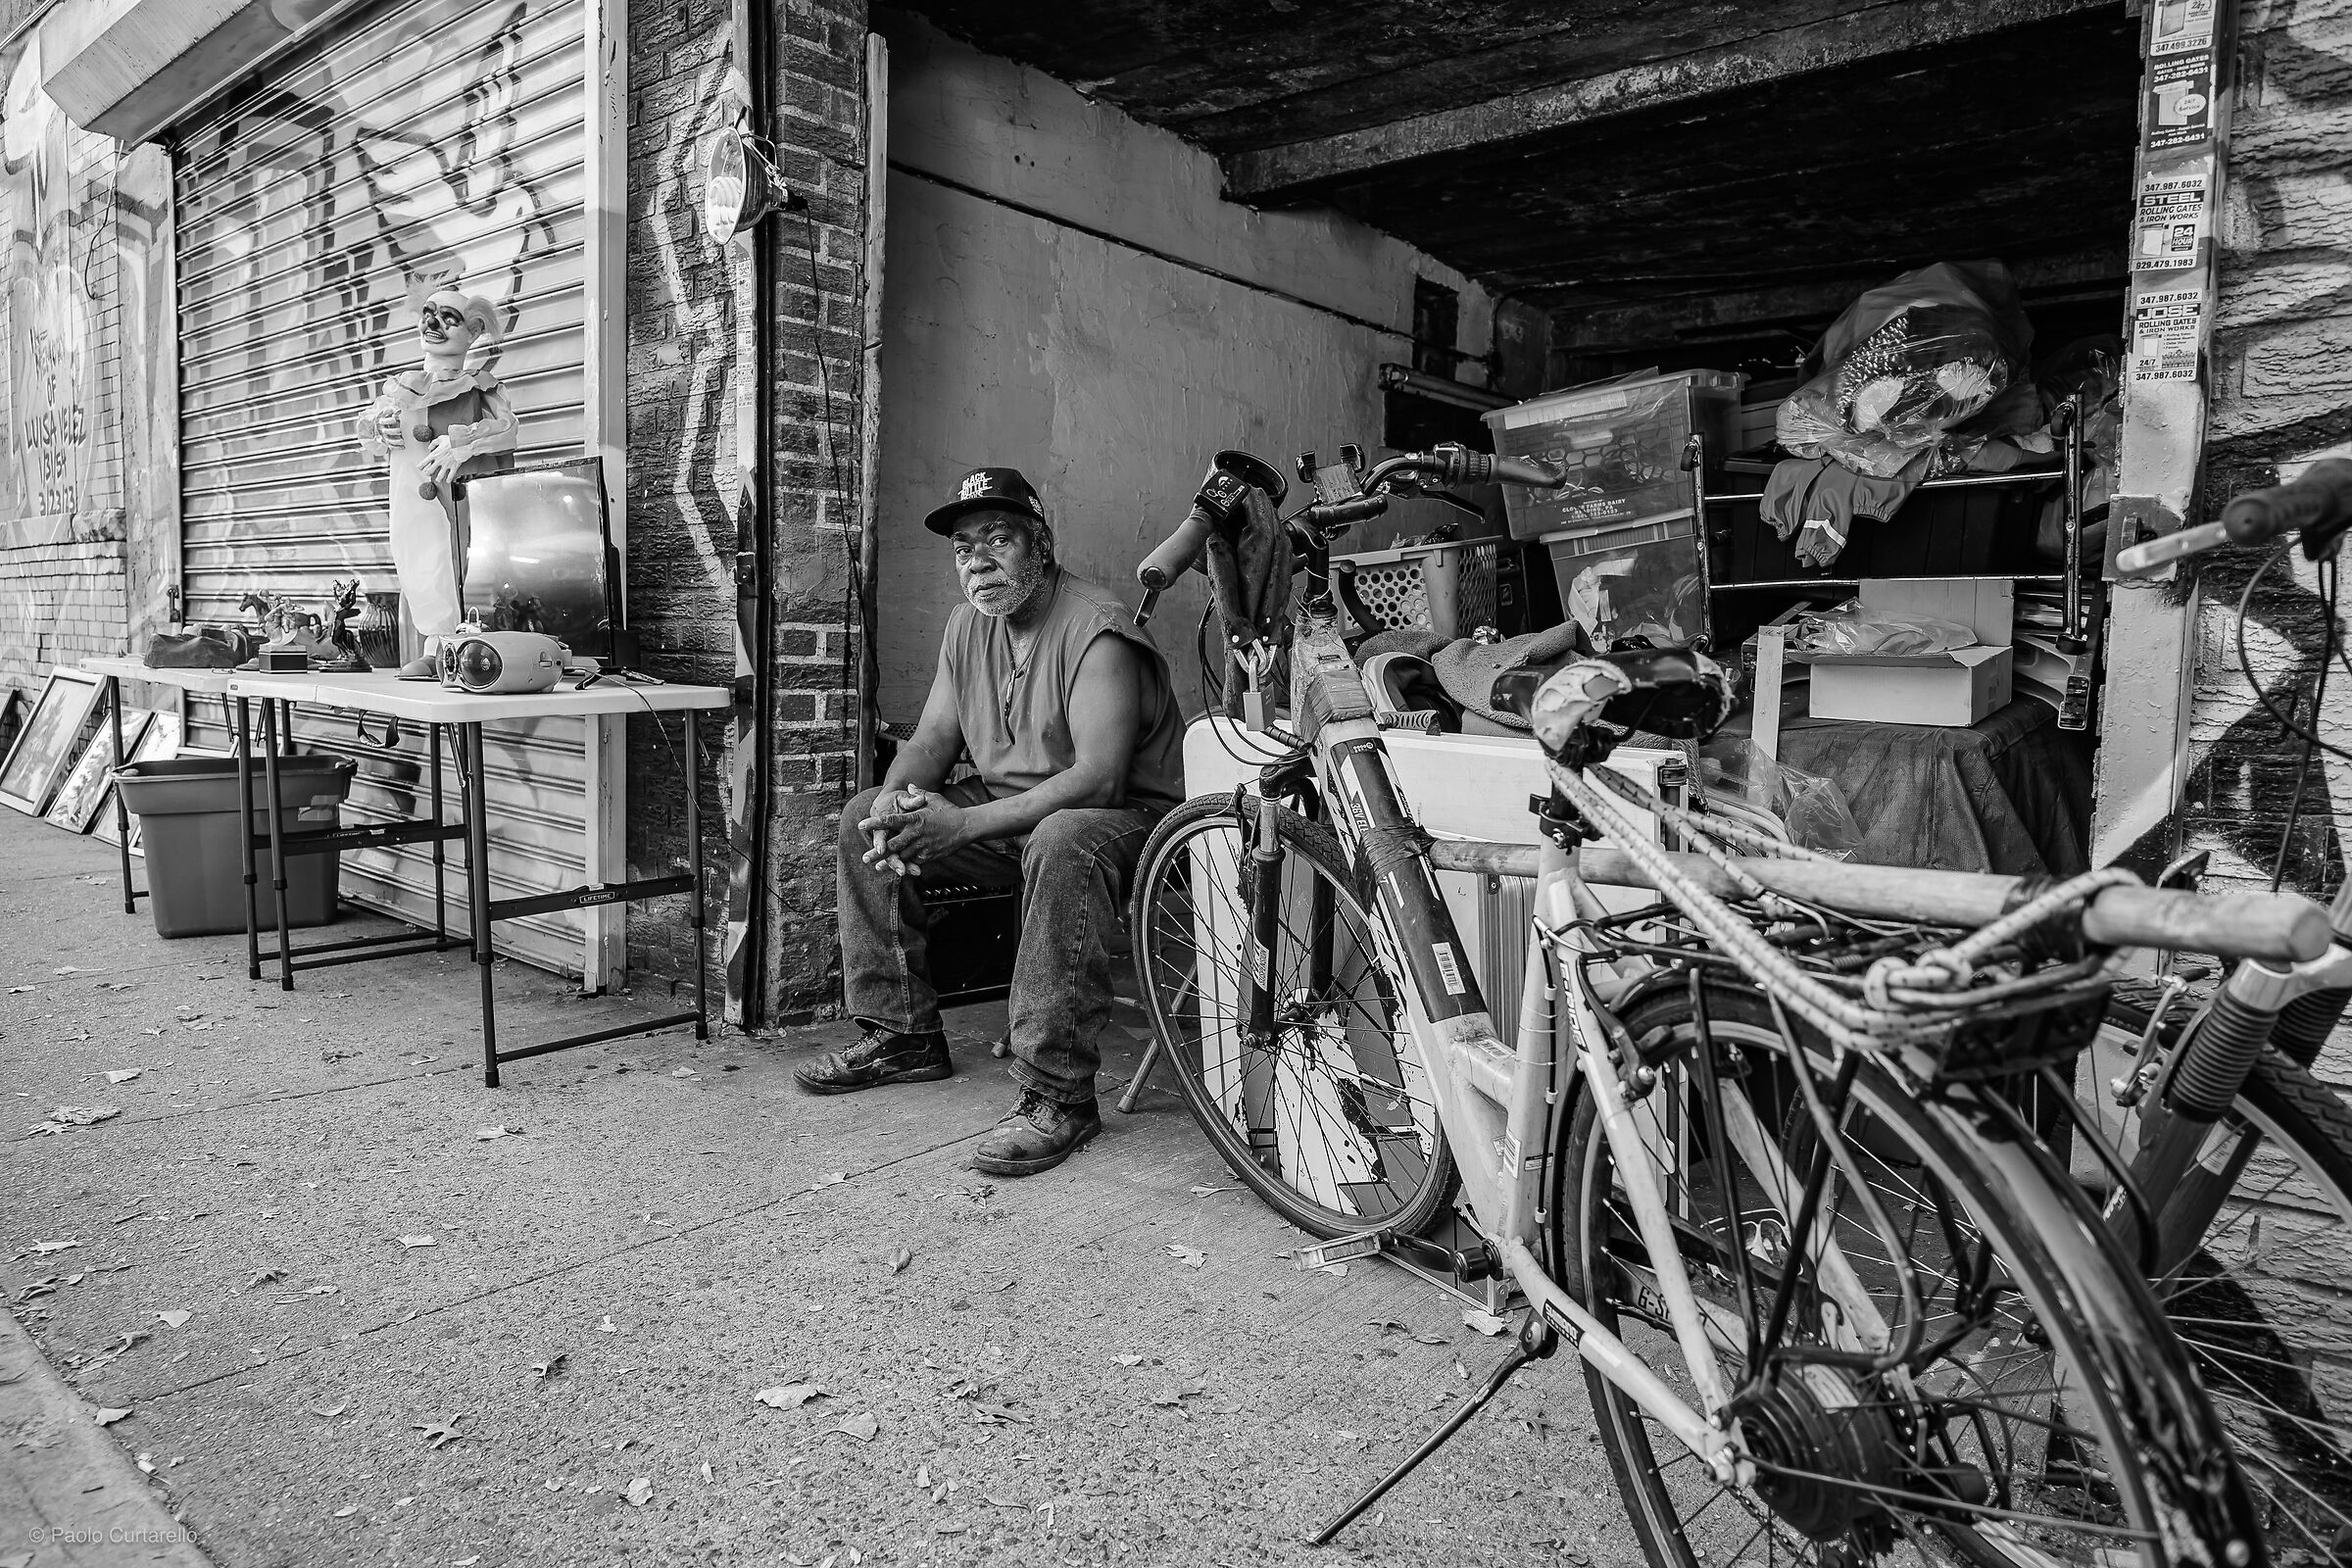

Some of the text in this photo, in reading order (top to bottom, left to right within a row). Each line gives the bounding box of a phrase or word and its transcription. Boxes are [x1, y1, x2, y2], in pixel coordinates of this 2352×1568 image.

[2145, 179, 2202, 191] 347.987.6032
[2143, 192, 2200, 206] STEEL
[2140, 204, 2202, 216] ROLLING GATES
[2175, 226, 2193, 237] 24
[2136, 259, 2193, 270] 929.479.1983
[2140, 292, 2198, 305] 347.987.6032
[2137, 304, 2198, 320] JOSE
[2139, 320, 2171, 329] ROLLING
[2136, 369, 2193, 381] 347.987.6032
[47, 373, 56, 407] OF
[24, 405, 86, 449] LUISA VELEZ
[962, 471, 992, 490] BLACK
[583, 893, 612, 902] LIFETIME
